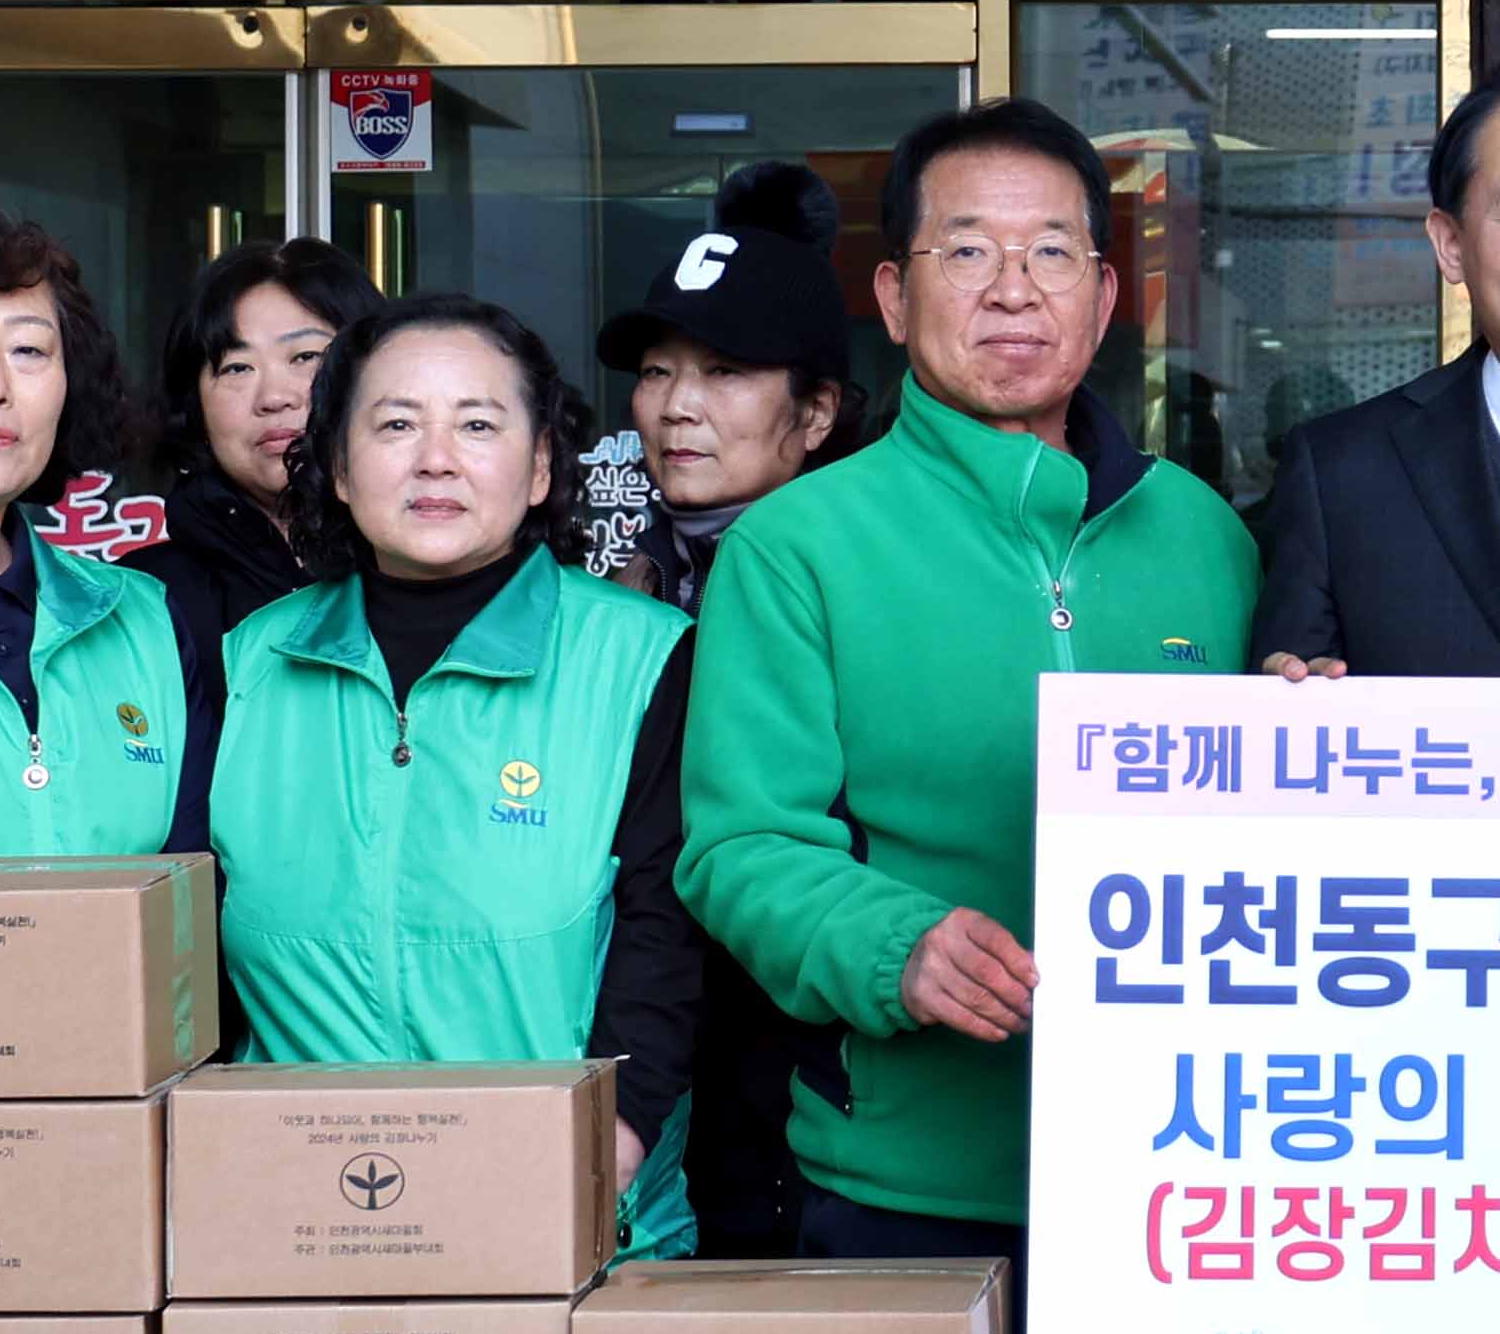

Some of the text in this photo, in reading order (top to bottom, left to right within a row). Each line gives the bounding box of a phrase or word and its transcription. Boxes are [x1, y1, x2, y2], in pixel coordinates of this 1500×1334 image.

[341, 74, 380, 86] CCTV
[356, 116, 408, 135] BOSS
[1161, 643, 1206, 664] SMU
[124, 743, 164, 765] SMU
[1275, 727, 1496, 799] 나누는,
[489, 804, 547, 827] SMU
[1151, 1051, 1466, 1162] 사랑의
